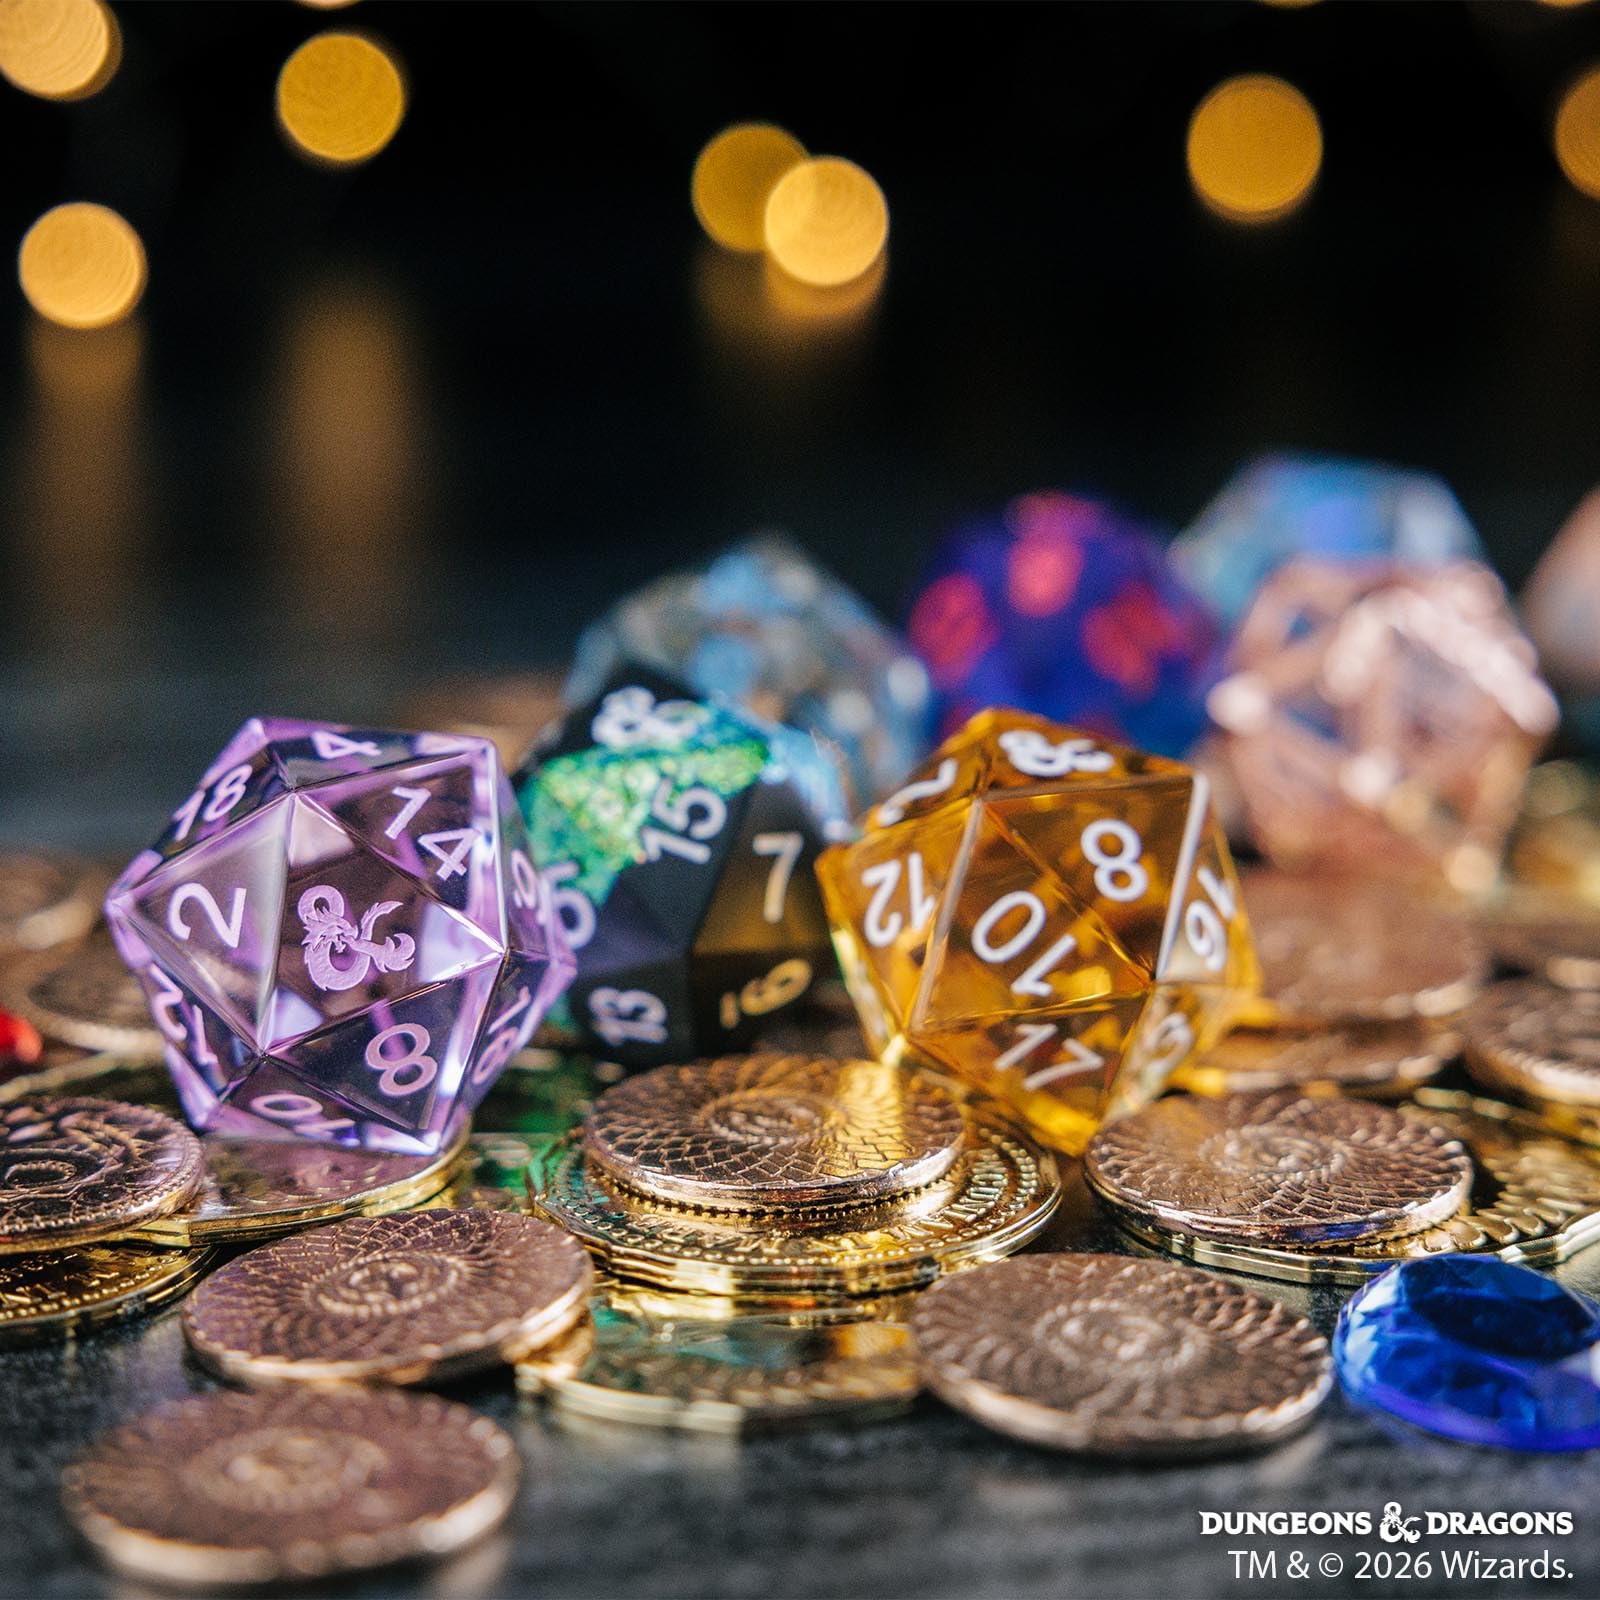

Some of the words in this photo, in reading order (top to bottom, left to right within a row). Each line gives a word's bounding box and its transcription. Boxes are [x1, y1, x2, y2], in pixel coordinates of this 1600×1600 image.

[173, 764, 253, 842] 18
[385, 787, 481, 881] 14
[641, 777, 727, 864] 15
[753, 832, 803, 923] 7
[1081, 819, 1148, 901] 8
[168, 882, 247, 949] 2
[972, 890, 1076, 996] 10
[364, 1022, 438, 1097] 8
[995, 1023, 1103, 1090] 17
